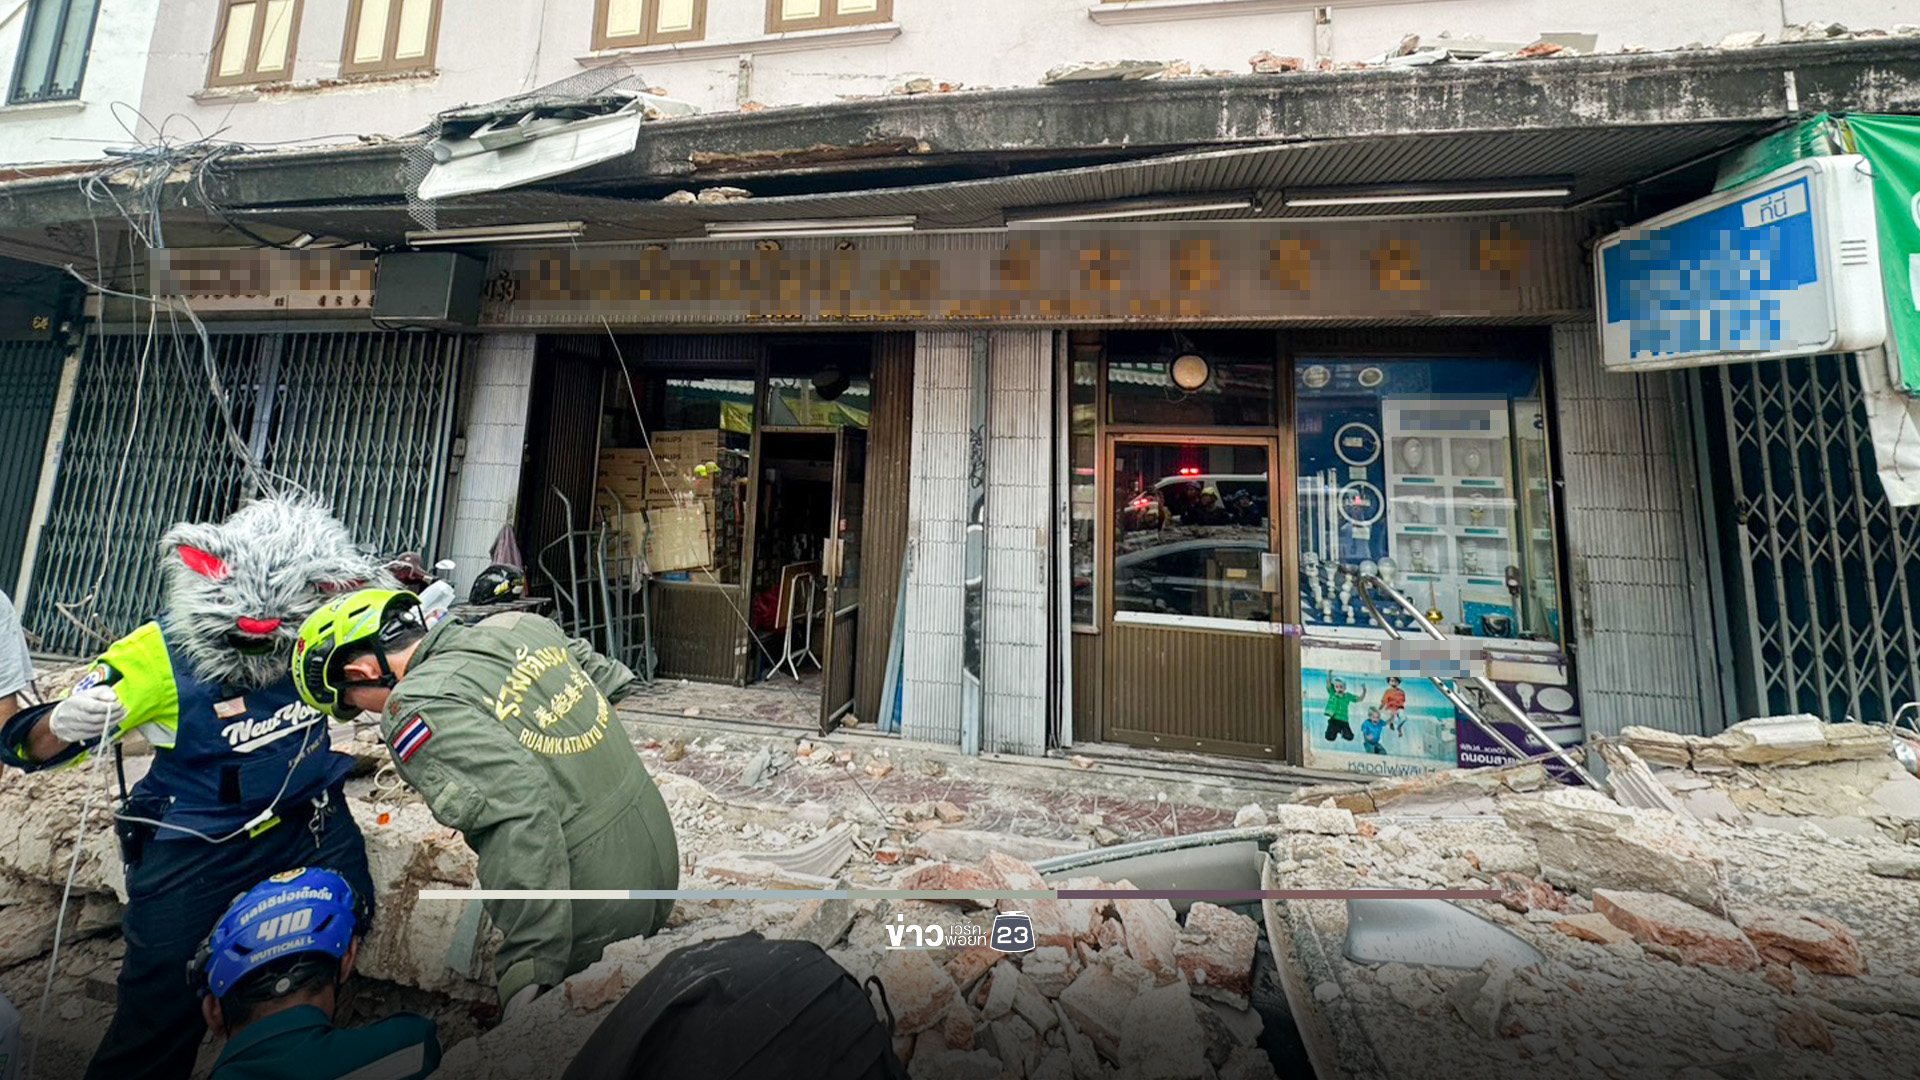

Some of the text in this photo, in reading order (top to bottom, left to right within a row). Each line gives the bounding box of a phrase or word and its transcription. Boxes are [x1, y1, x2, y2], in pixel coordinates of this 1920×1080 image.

[1760, 191, 1788, 223] ที่นี่
[221, 718, 281, 746] New
[519, 725, 603, 755] RUAMKATANYU
[256, 907, 313, 942] 410
